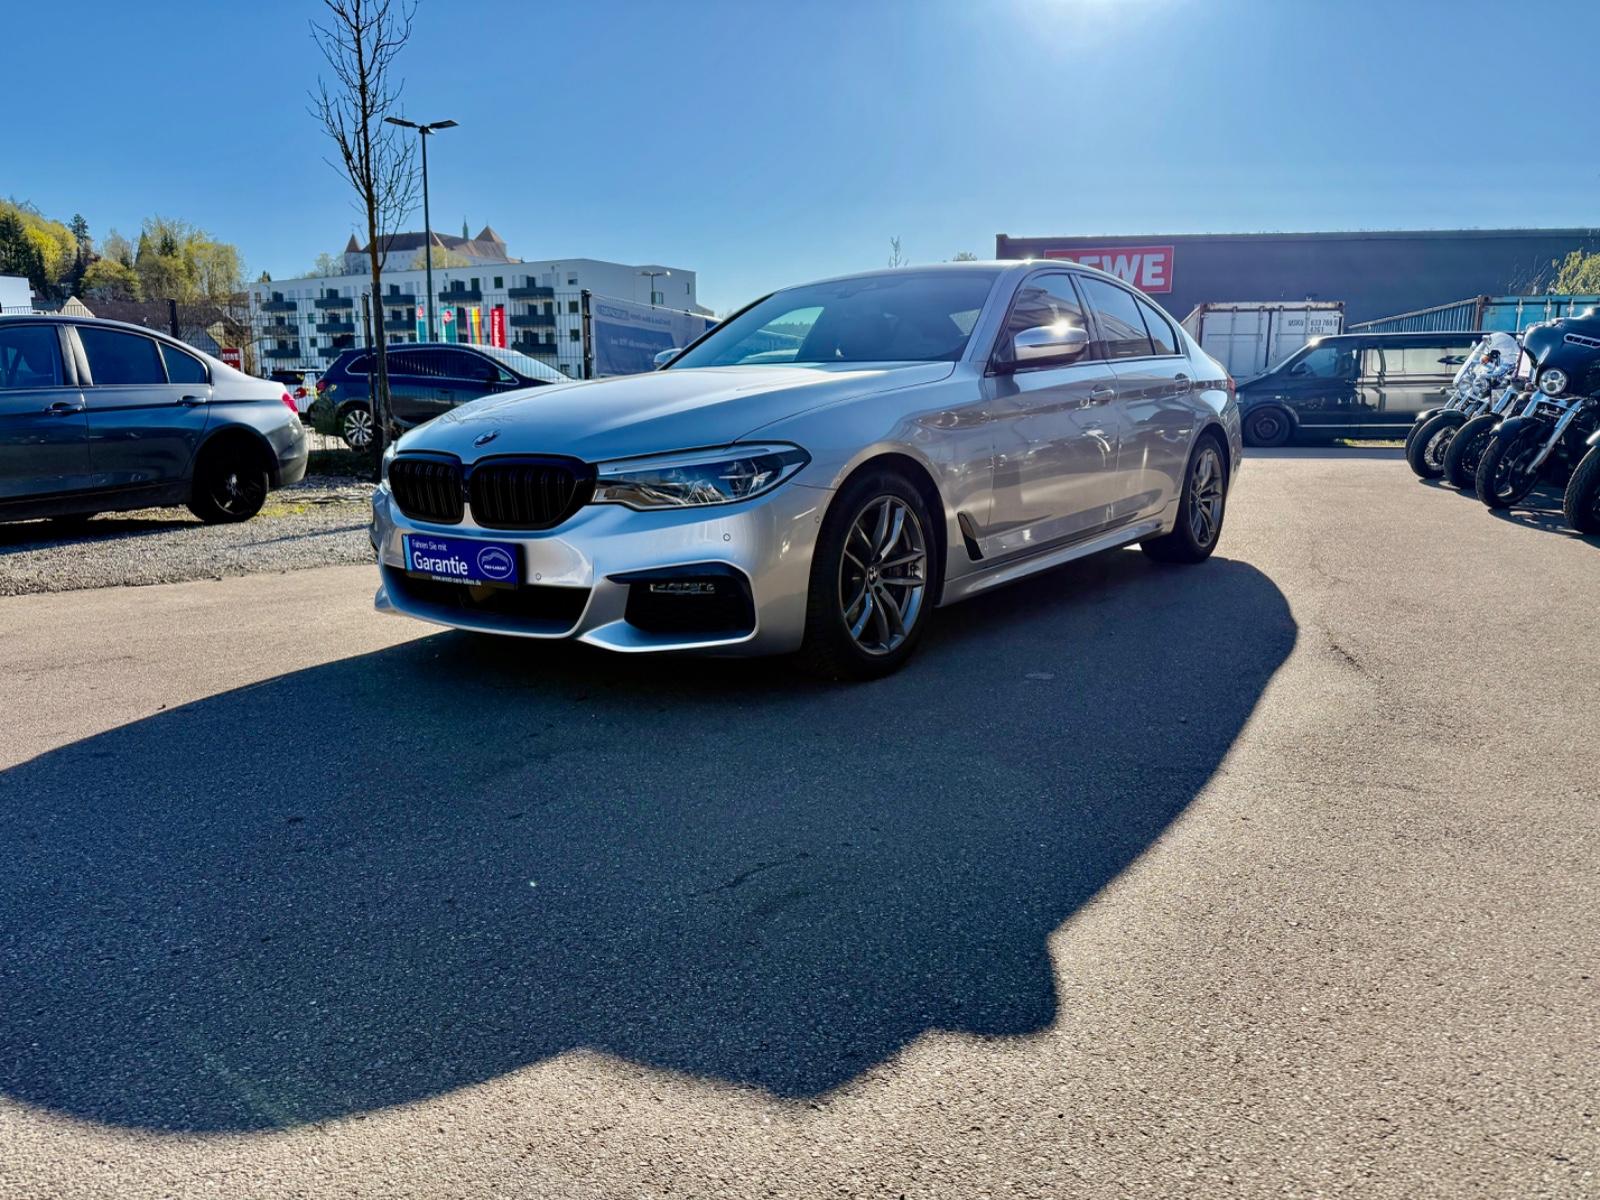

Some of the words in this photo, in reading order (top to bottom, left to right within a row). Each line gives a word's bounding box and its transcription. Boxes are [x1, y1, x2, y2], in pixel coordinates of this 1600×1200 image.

[1051, 253, 1165, 287] WE
[411, 539, 428, 549] Fahren
[428, 541, 438, 551] Sie
[438, 543, 447, 552] mit
[413, 551, 468, 575] Garantie
